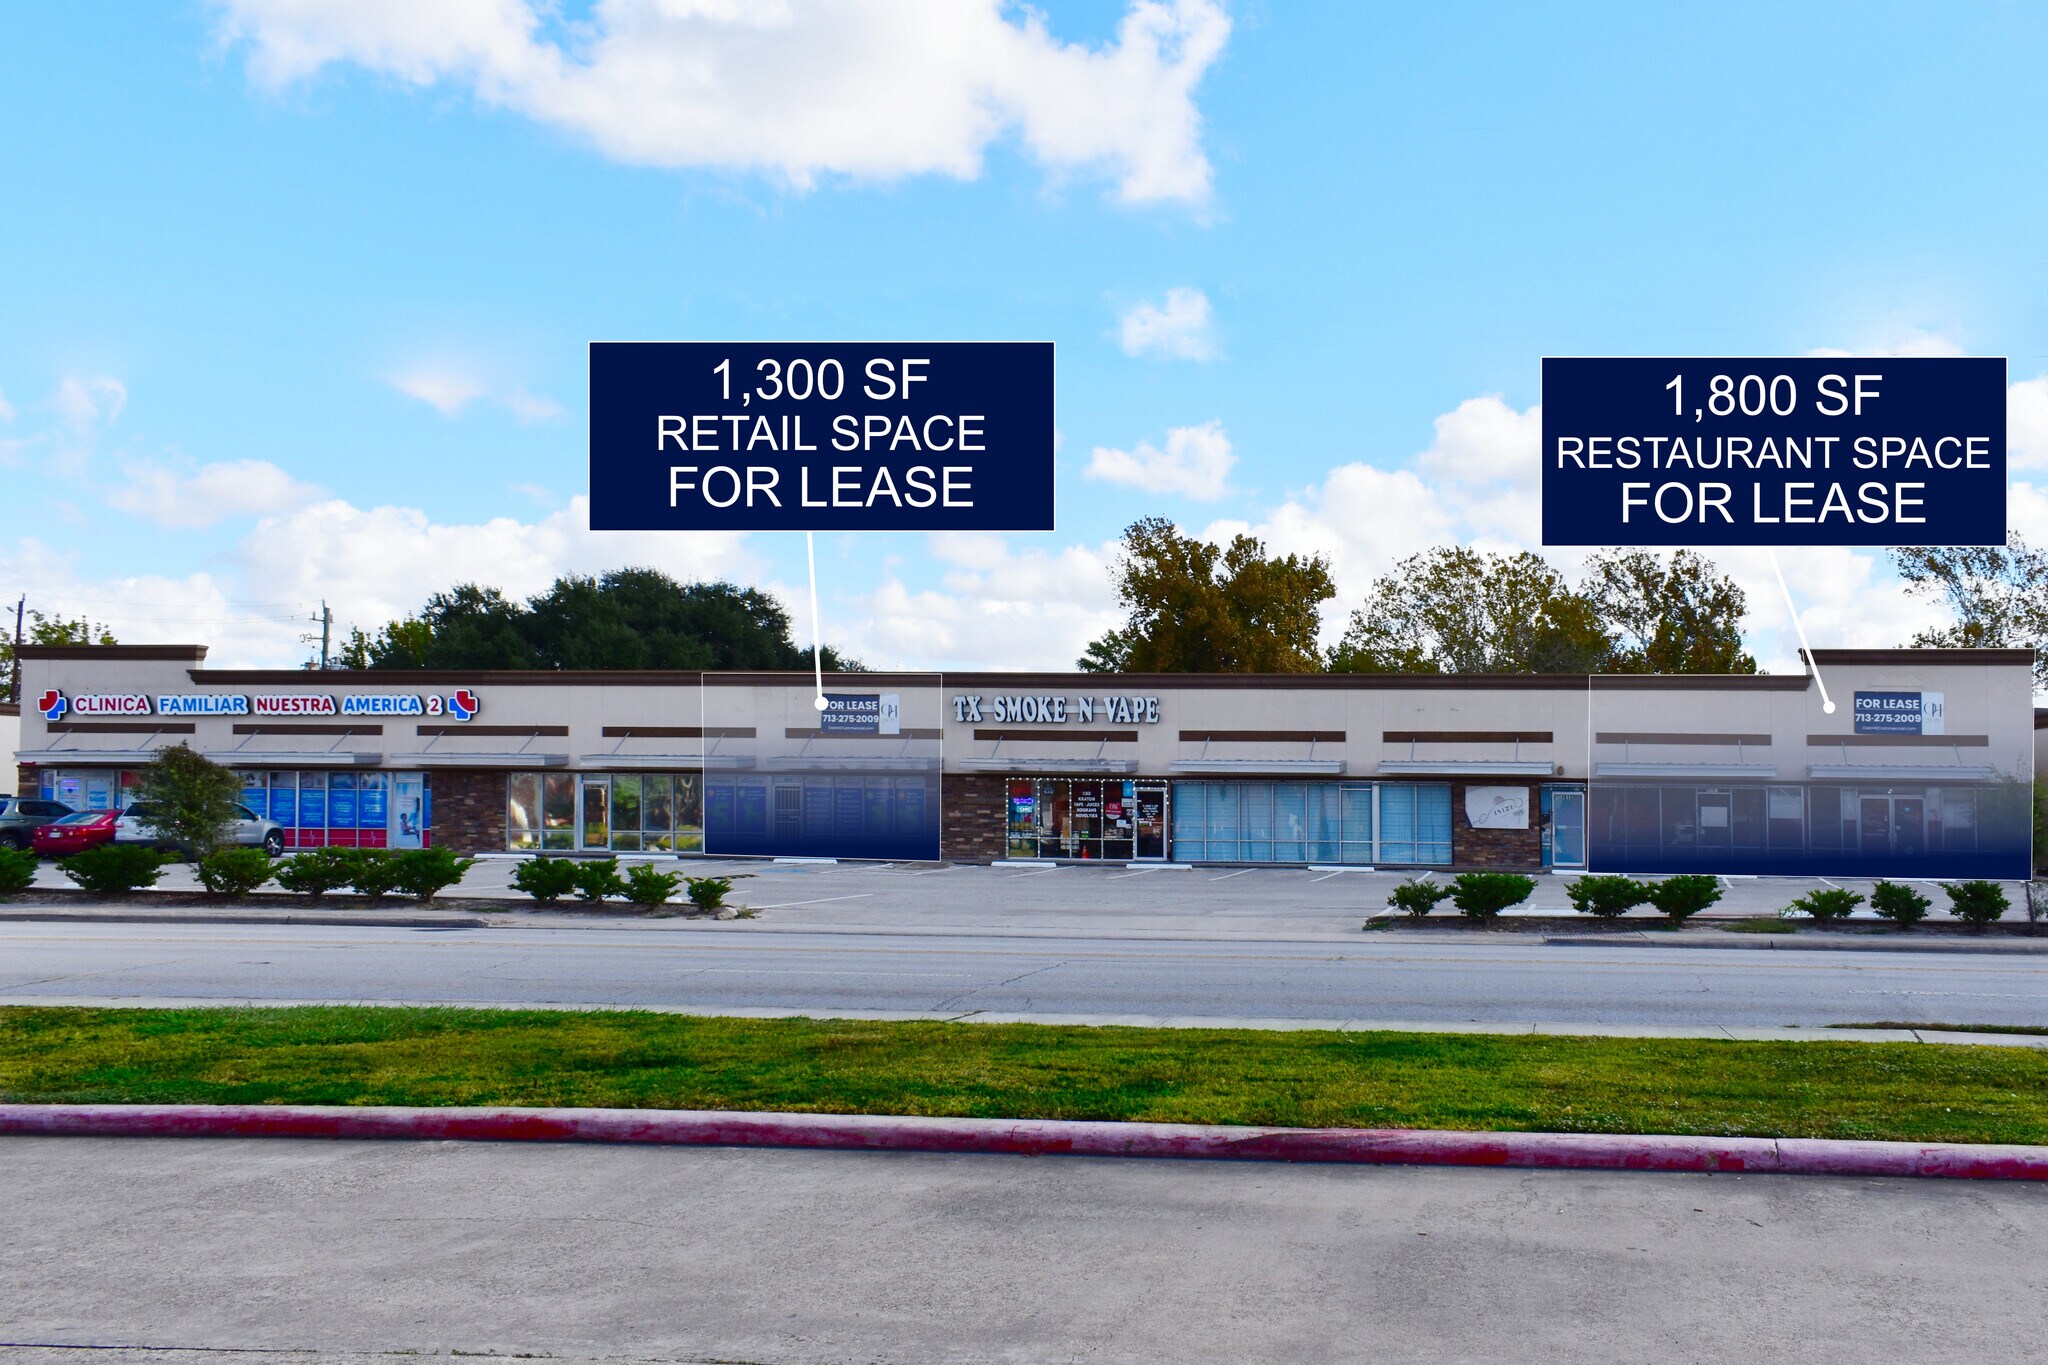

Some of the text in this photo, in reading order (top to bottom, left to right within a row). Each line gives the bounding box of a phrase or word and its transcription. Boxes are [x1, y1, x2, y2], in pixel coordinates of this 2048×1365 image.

[74, 696, 441, 713] CLINICA FAMILIAR NUESTRA AMERICA 2
[847, 701, 877, 710] LEASE
[1856, 699, 1919, 708] FOR LEASE
[953, 695, 1159, 724] TX SMOKE N VAPE
[1855, 714, 1921, 722] 713-275-2009
